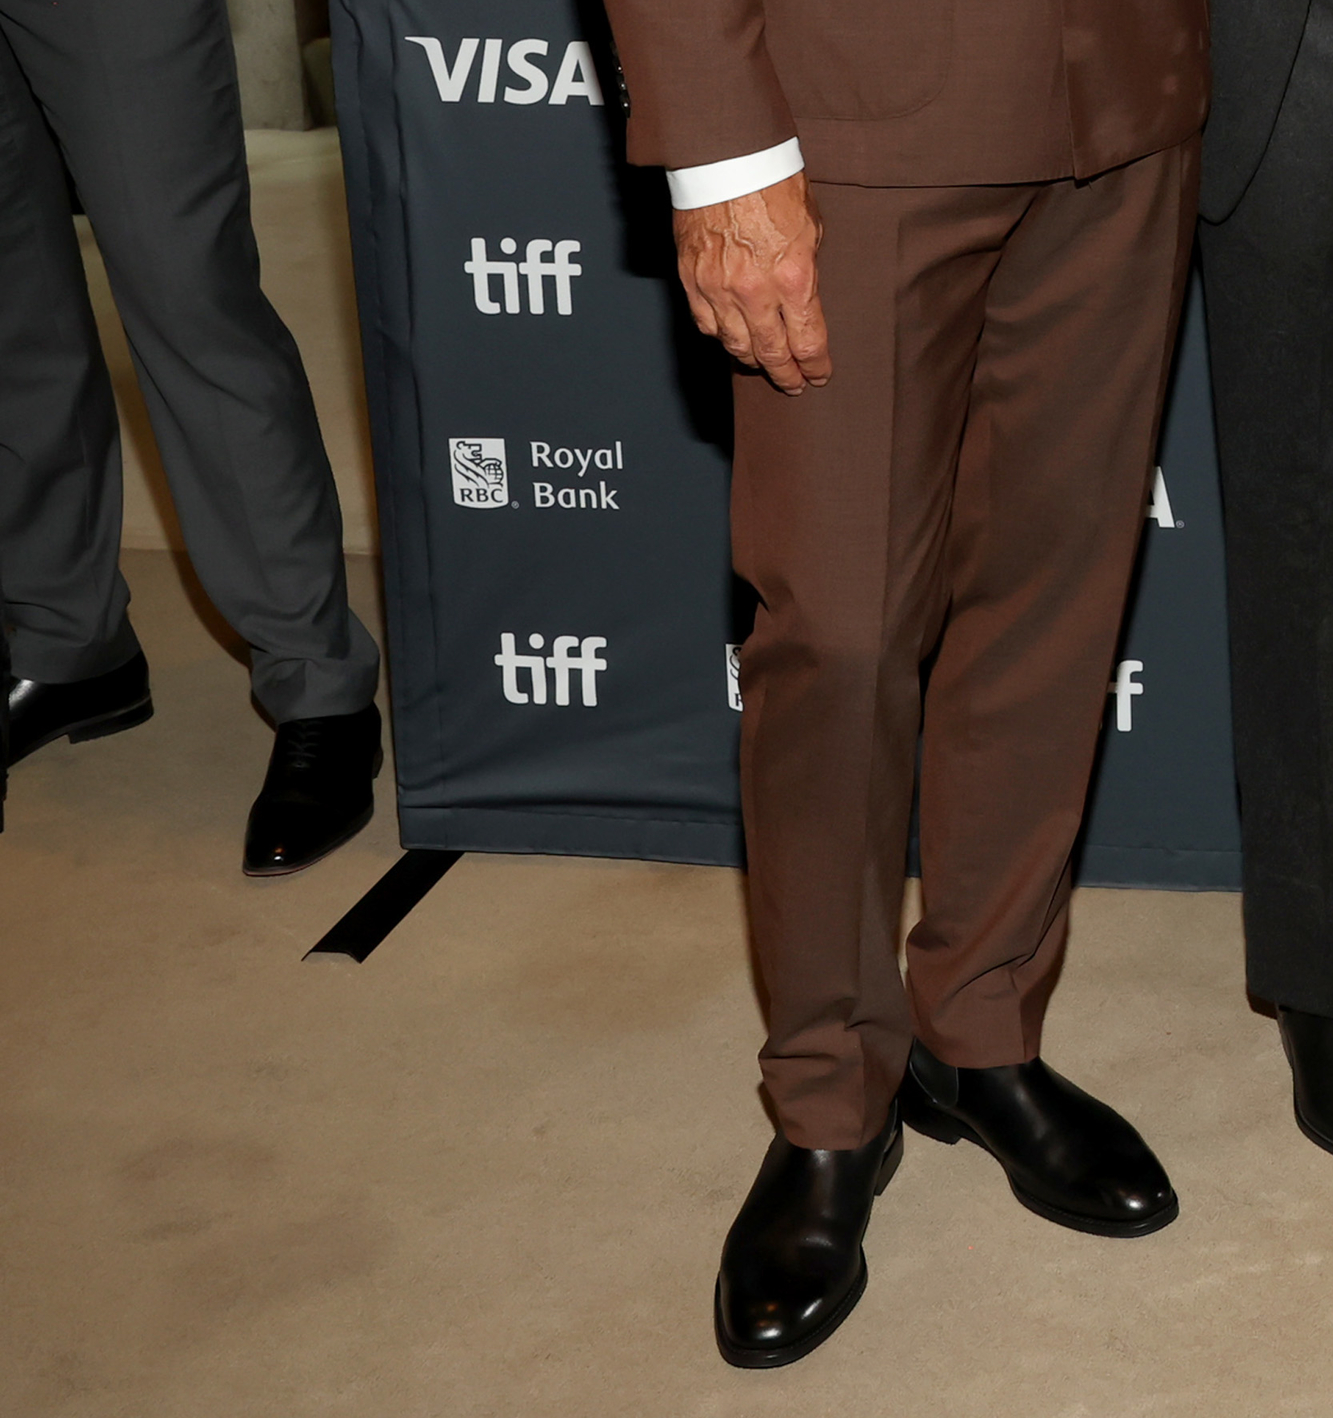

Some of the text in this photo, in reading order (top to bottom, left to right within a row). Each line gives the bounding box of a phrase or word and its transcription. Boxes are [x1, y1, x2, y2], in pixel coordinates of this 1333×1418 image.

[404, 36, 604, 106] VISA
[464, 237, 582, 316] tiff
[530, 440, 623, 475] Royal
[459, 488, 503, 503] RBC
[532, 480, 620, 510] Bank
[494, 632, 607, 707] tiff
